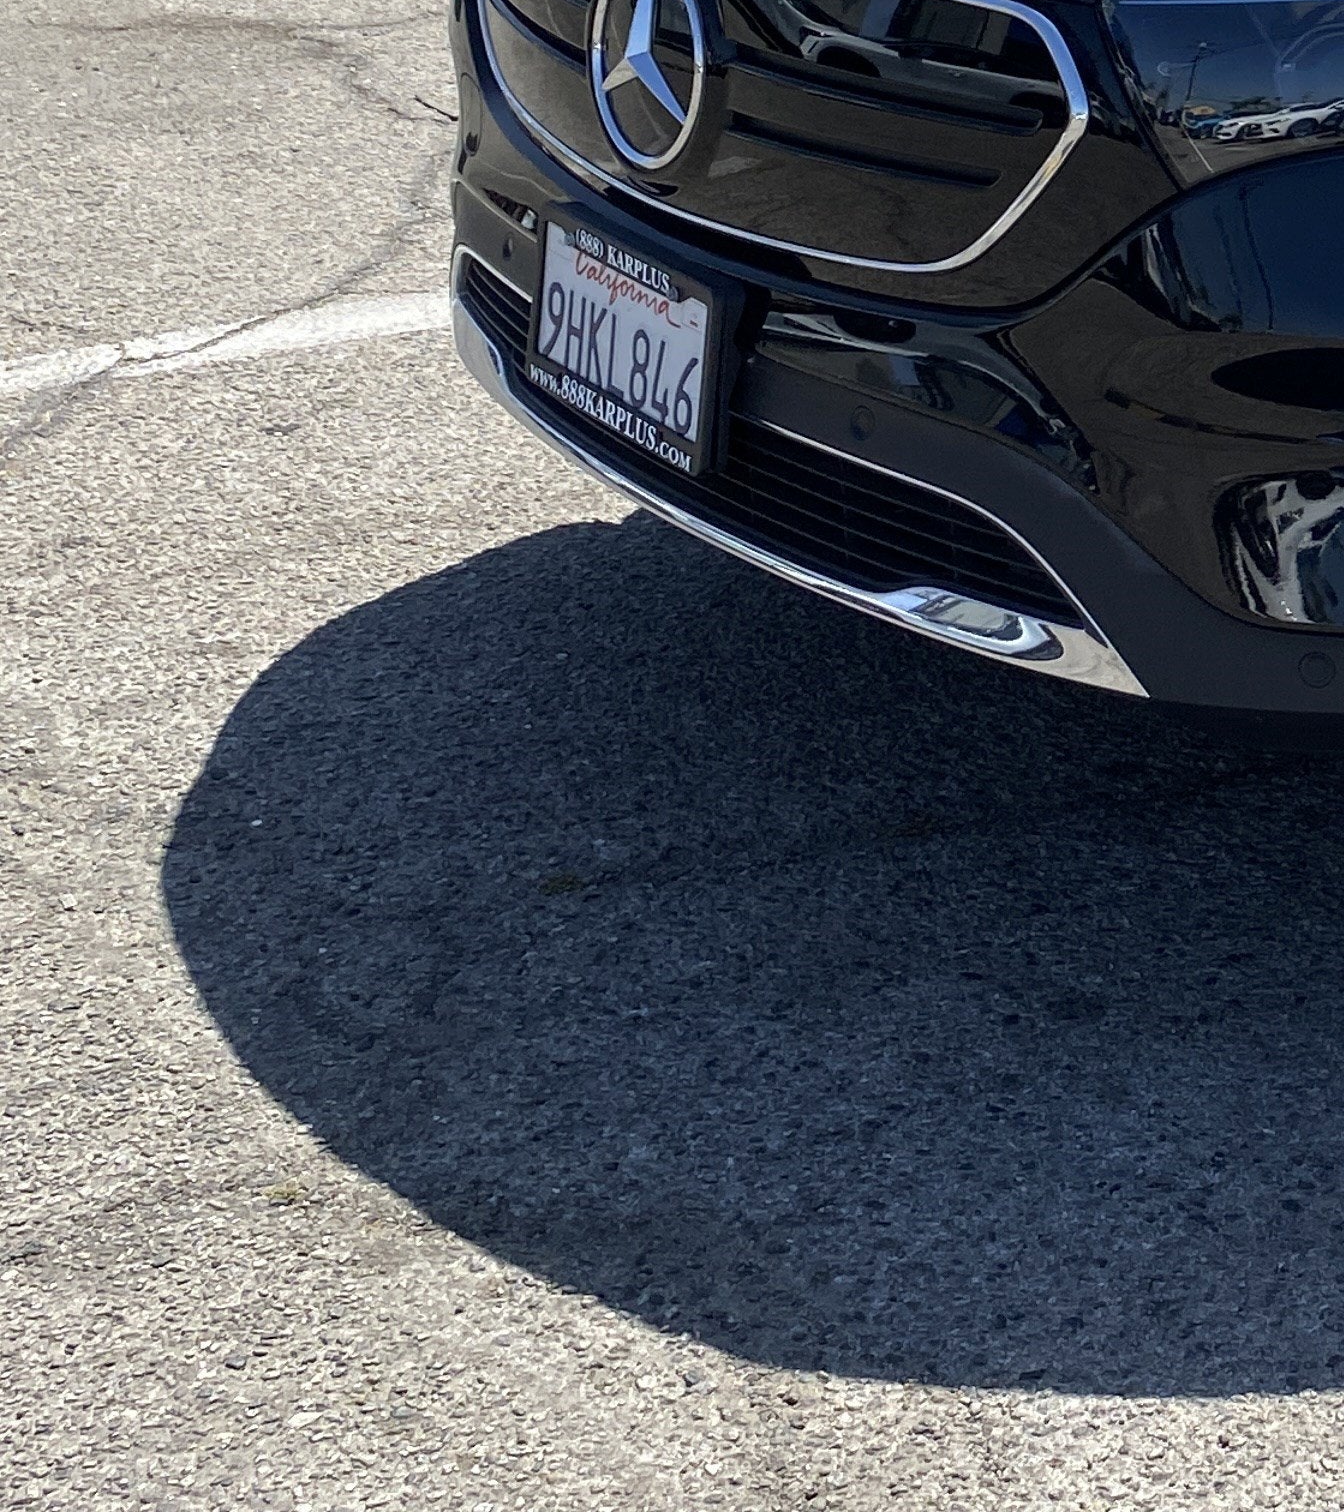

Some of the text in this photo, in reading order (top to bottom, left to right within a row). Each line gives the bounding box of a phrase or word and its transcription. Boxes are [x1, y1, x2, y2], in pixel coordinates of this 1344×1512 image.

[573, 251, 682, 329] California
[575, 227, 671, 292] (888) KARPLUS
[547, 281, 699, 436] 9HKL846
